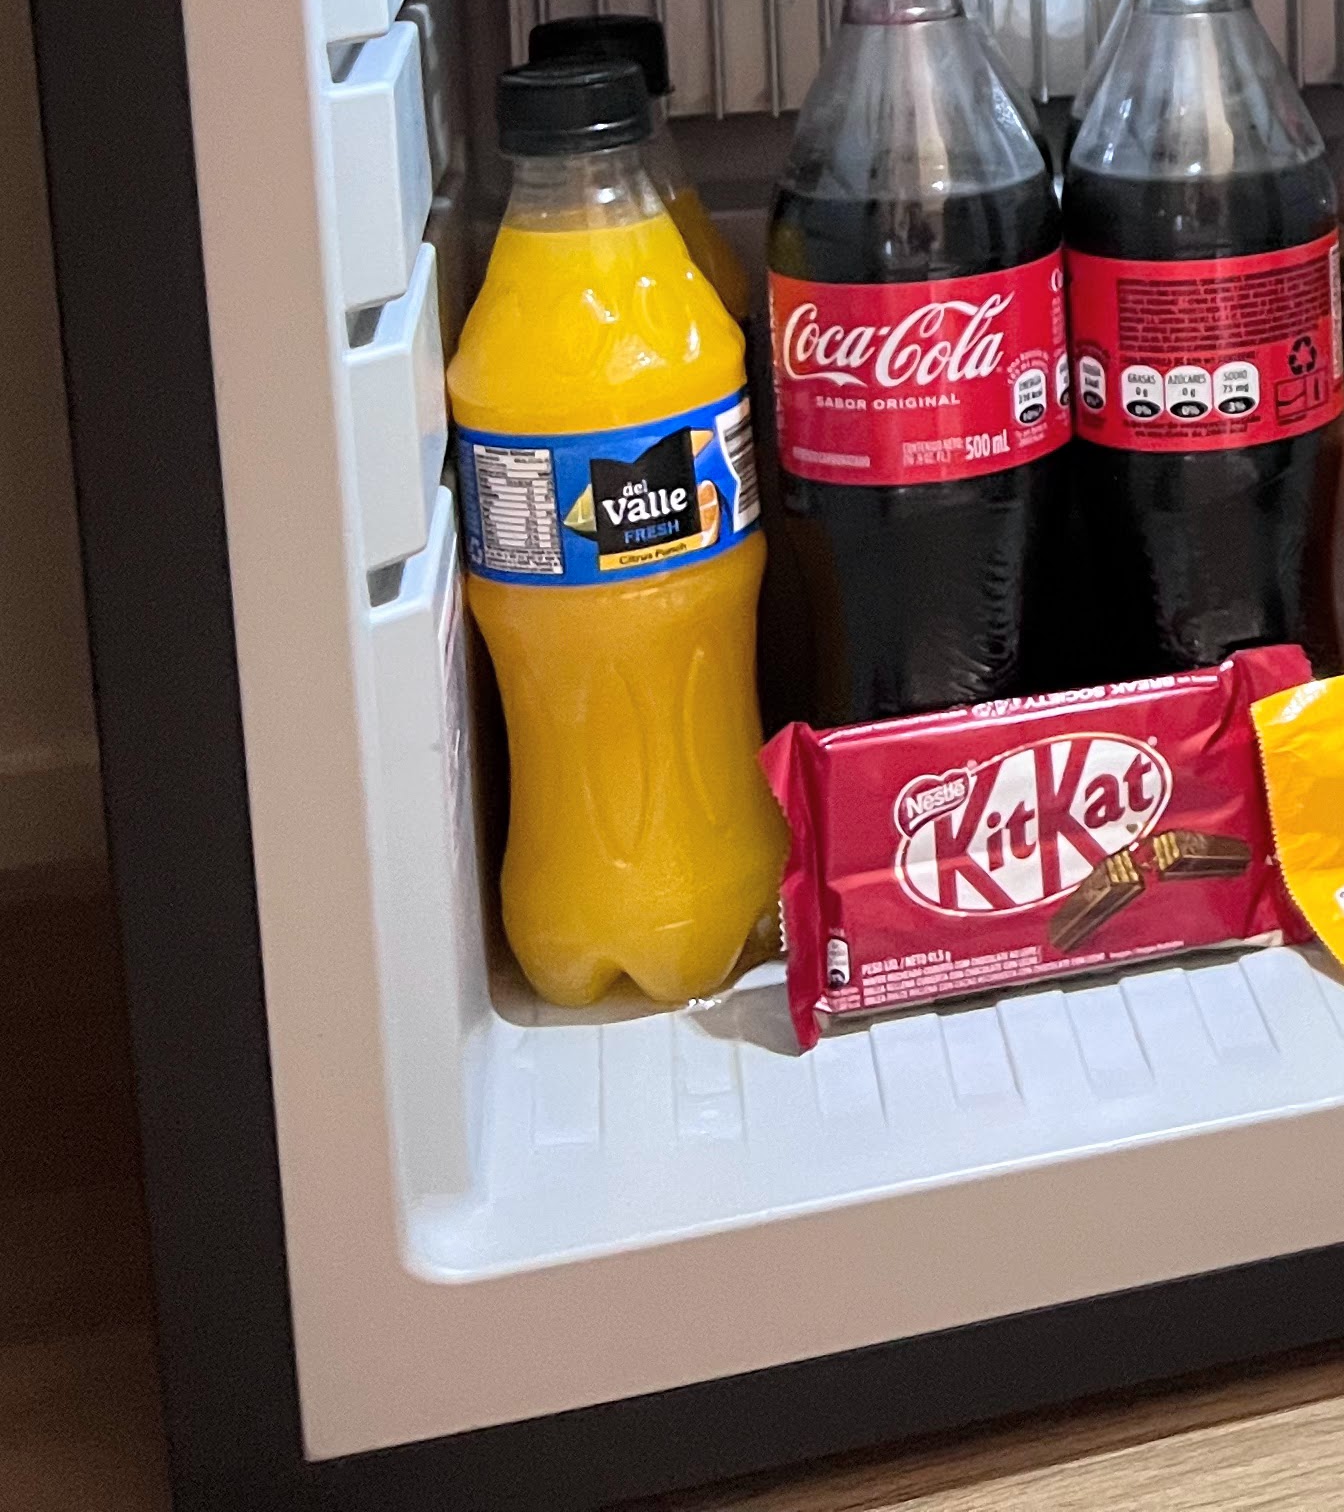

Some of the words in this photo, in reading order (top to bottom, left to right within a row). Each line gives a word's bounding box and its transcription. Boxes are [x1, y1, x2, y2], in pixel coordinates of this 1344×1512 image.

[783, 291, 1015, 386] Coca-Cola
[816, 395, 867, 410] SABOR
[874, 392, 961, 410] ORIGINAL
[965, 433, 990, 460] 500
[623, 479, 648, 497] del
[602, 488, 688, 525] Valle
[624, 519, 680, 544] FRESH
[619, 552, 653, 565] Citrus
[1110, 676, 1175, 695] BREAK
[1024, 686, 1106, 710] SOCIETY
[933, 739, 1154, 910] KitKat
